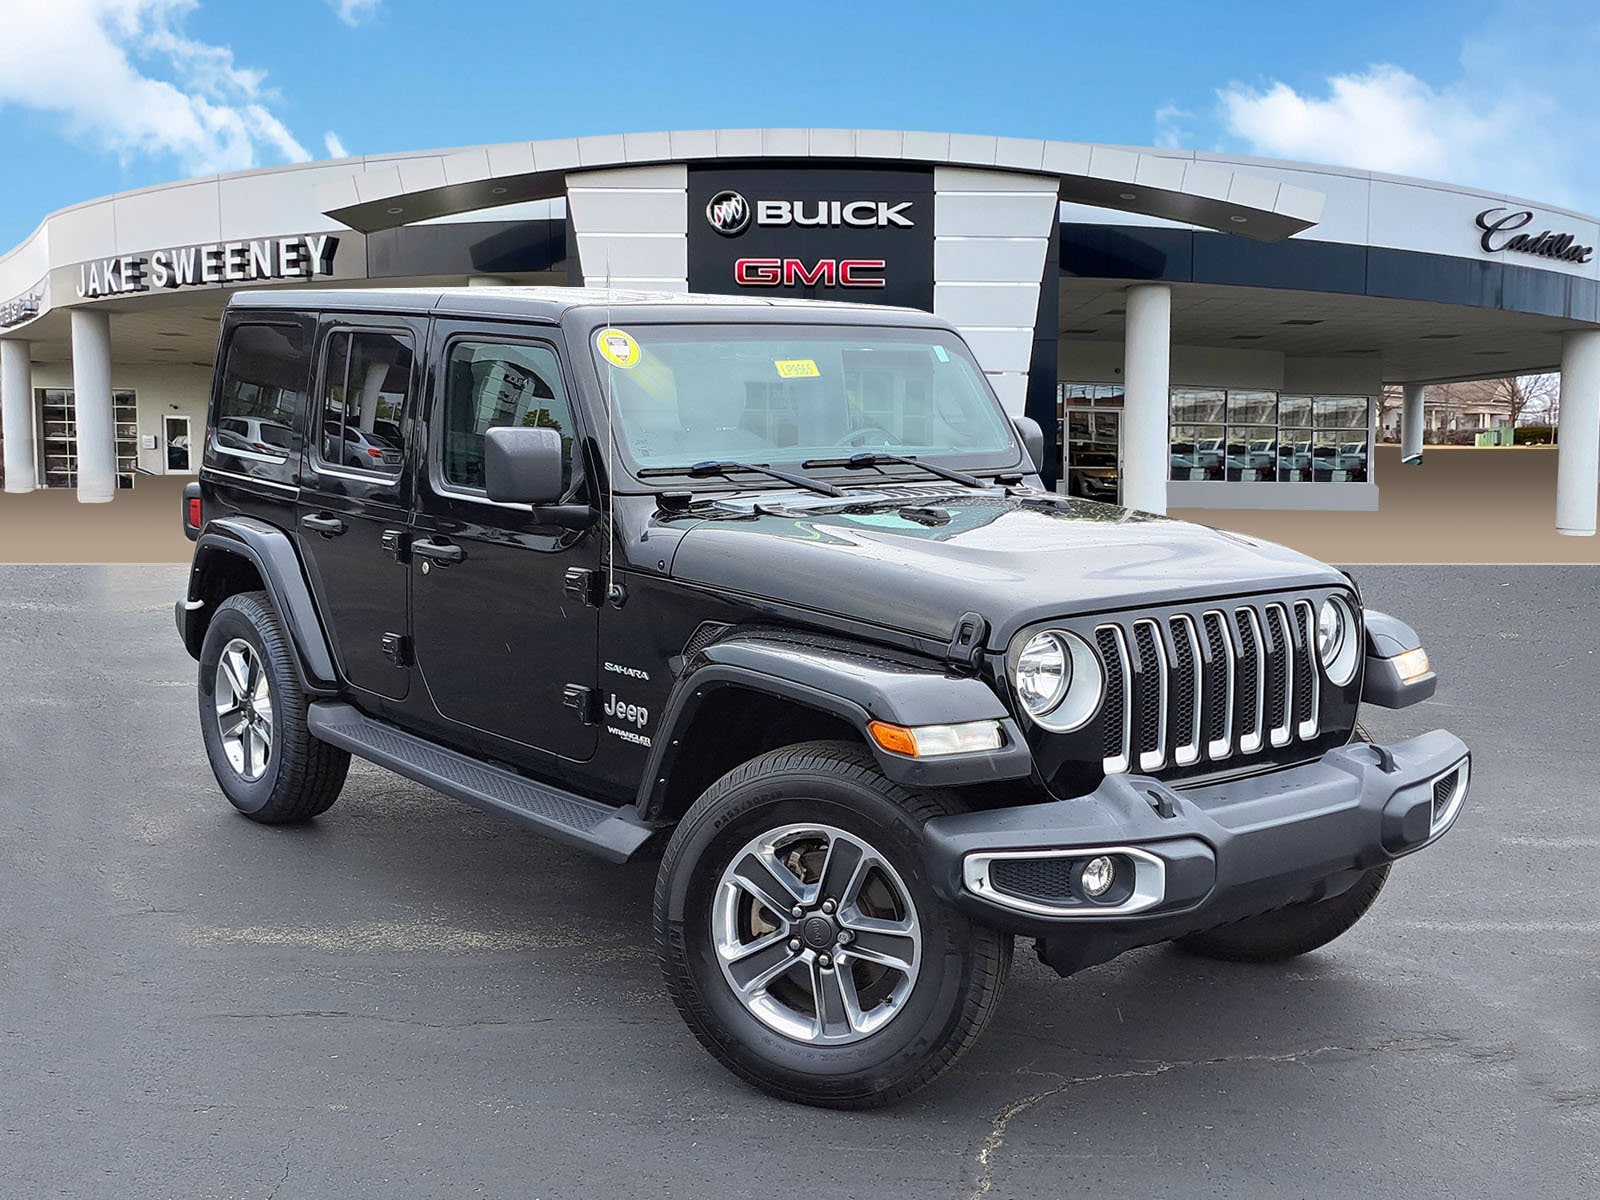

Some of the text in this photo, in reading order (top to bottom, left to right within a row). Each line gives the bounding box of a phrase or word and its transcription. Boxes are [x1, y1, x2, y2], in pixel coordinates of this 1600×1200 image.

[757, 200, 915, 226] BUICK
[1475, 207, 1593, 263] Cadillac
[76, 234, 337, 298] JAKE SWEENEY
[735, 258, 886, 287] GMC
[604, 661, 649, 680] SAHARA
[604, 693, 649, 729] Jeep
